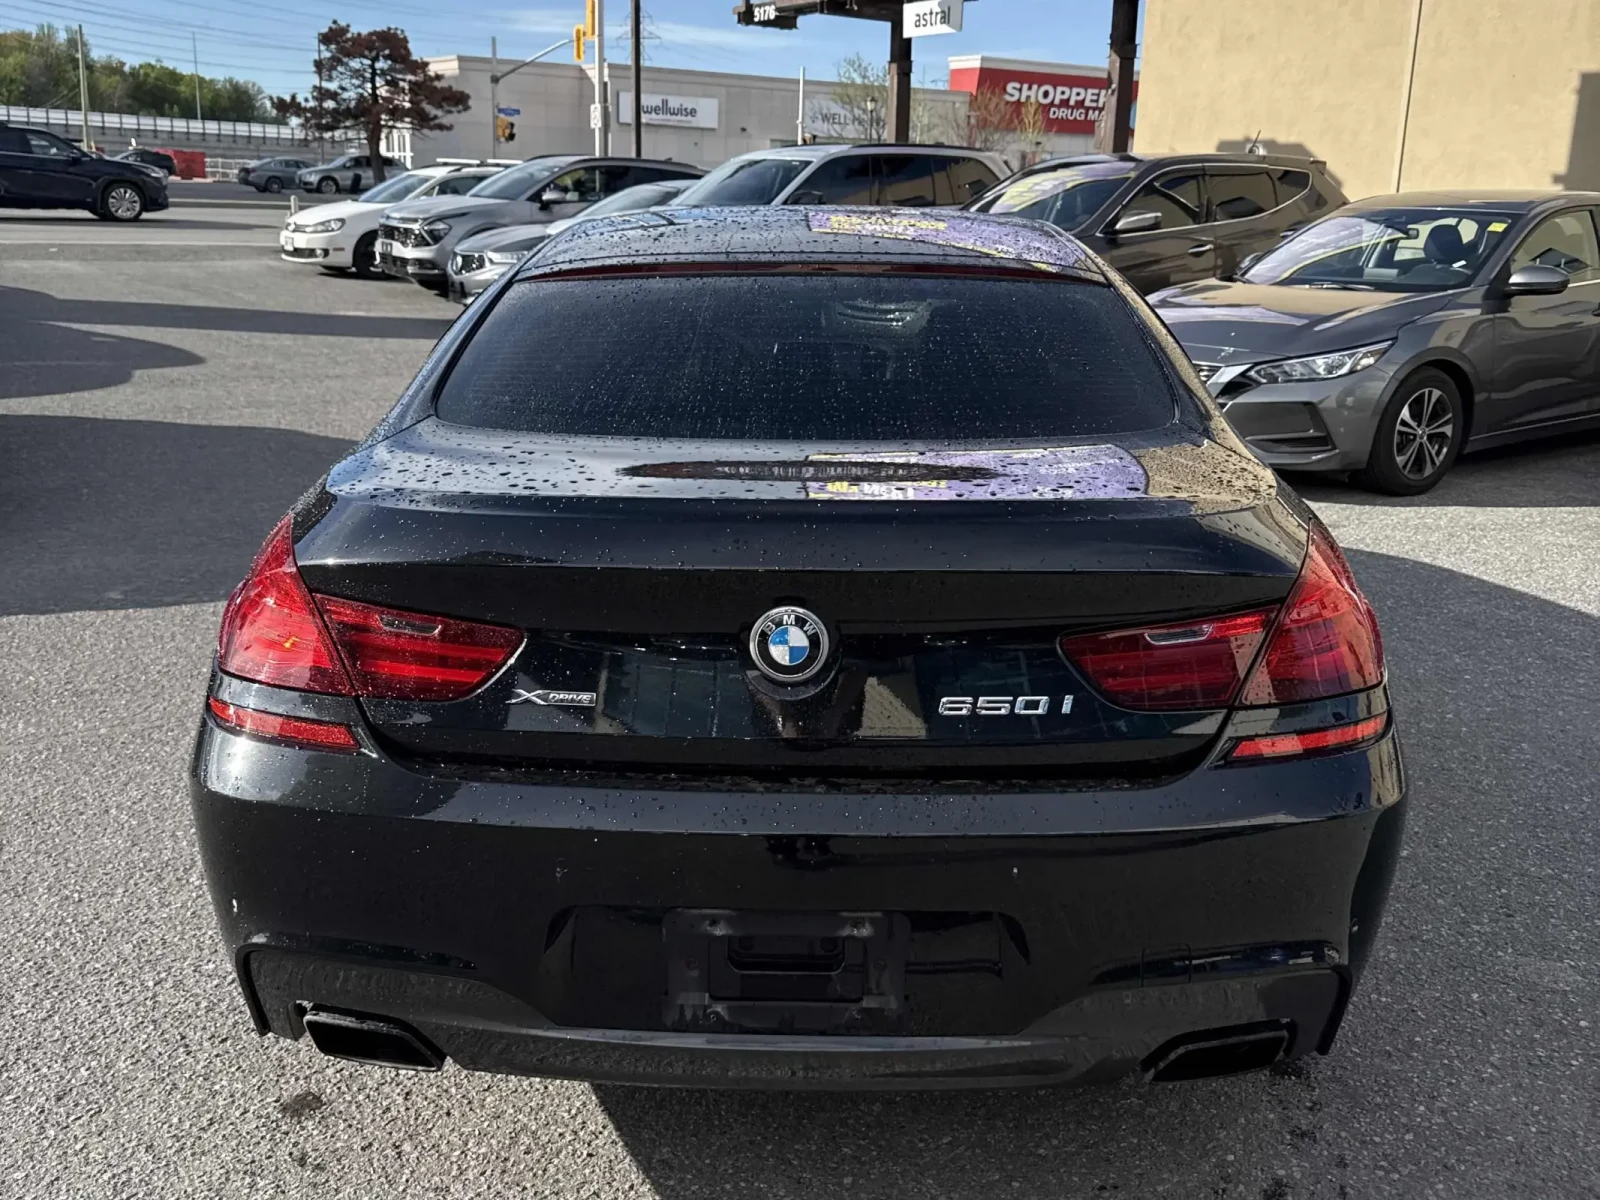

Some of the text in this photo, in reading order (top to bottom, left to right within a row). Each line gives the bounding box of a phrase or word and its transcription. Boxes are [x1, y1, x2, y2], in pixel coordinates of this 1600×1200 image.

[753, 4, 776, 22] 5176
[914, 5, 951, 28] astral
[641, 98, 698, 118] wellwise
[1049, 107, 1106, 121] DRUG MA
[820, 112, 849, 126] WELL
[762, 614, 818, 637] BMW
